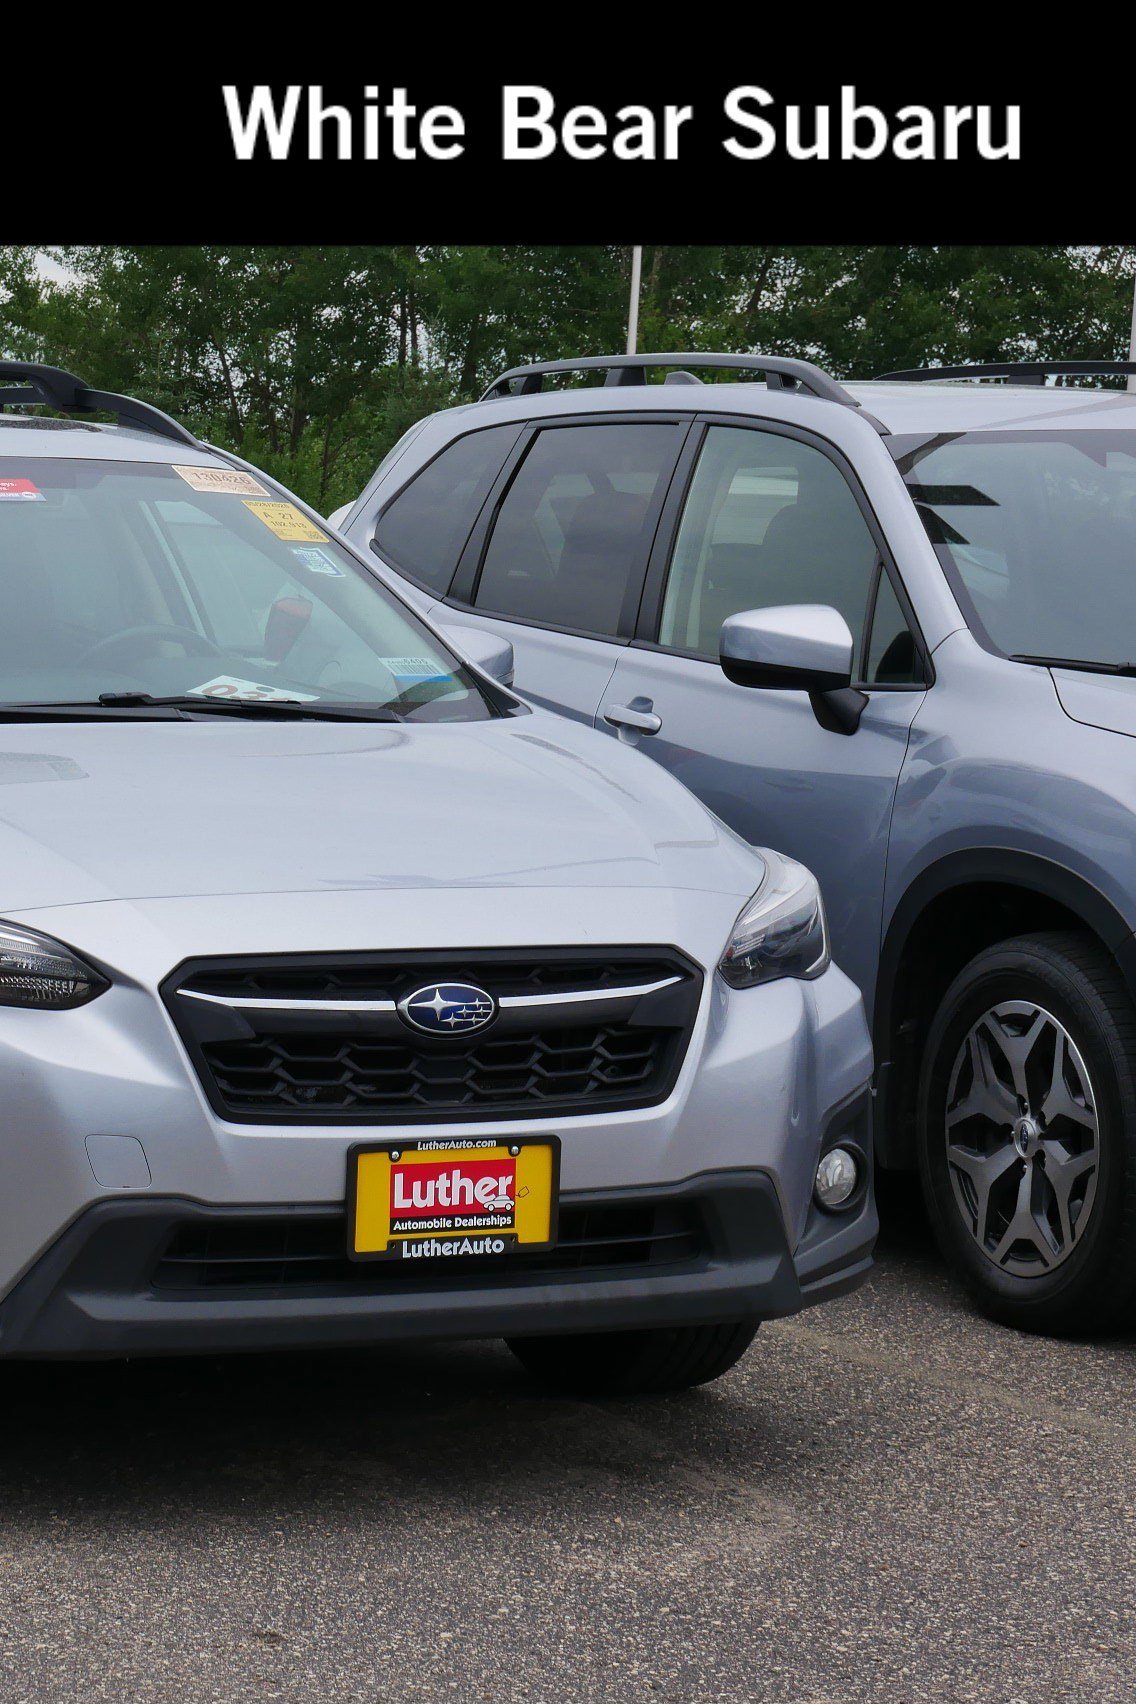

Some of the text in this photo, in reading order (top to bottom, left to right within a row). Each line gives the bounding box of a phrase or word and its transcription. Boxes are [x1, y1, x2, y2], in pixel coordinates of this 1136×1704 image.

[279, 512, 294, 520] 27
[417, 1139, 497, 1151] LutherAuto.com
[394, 1169, 514, 1209] Luther
[393, 1214, 512, 1231] Automobile Dealerships
[402, 1237, 505, 1259] LutherAuto
